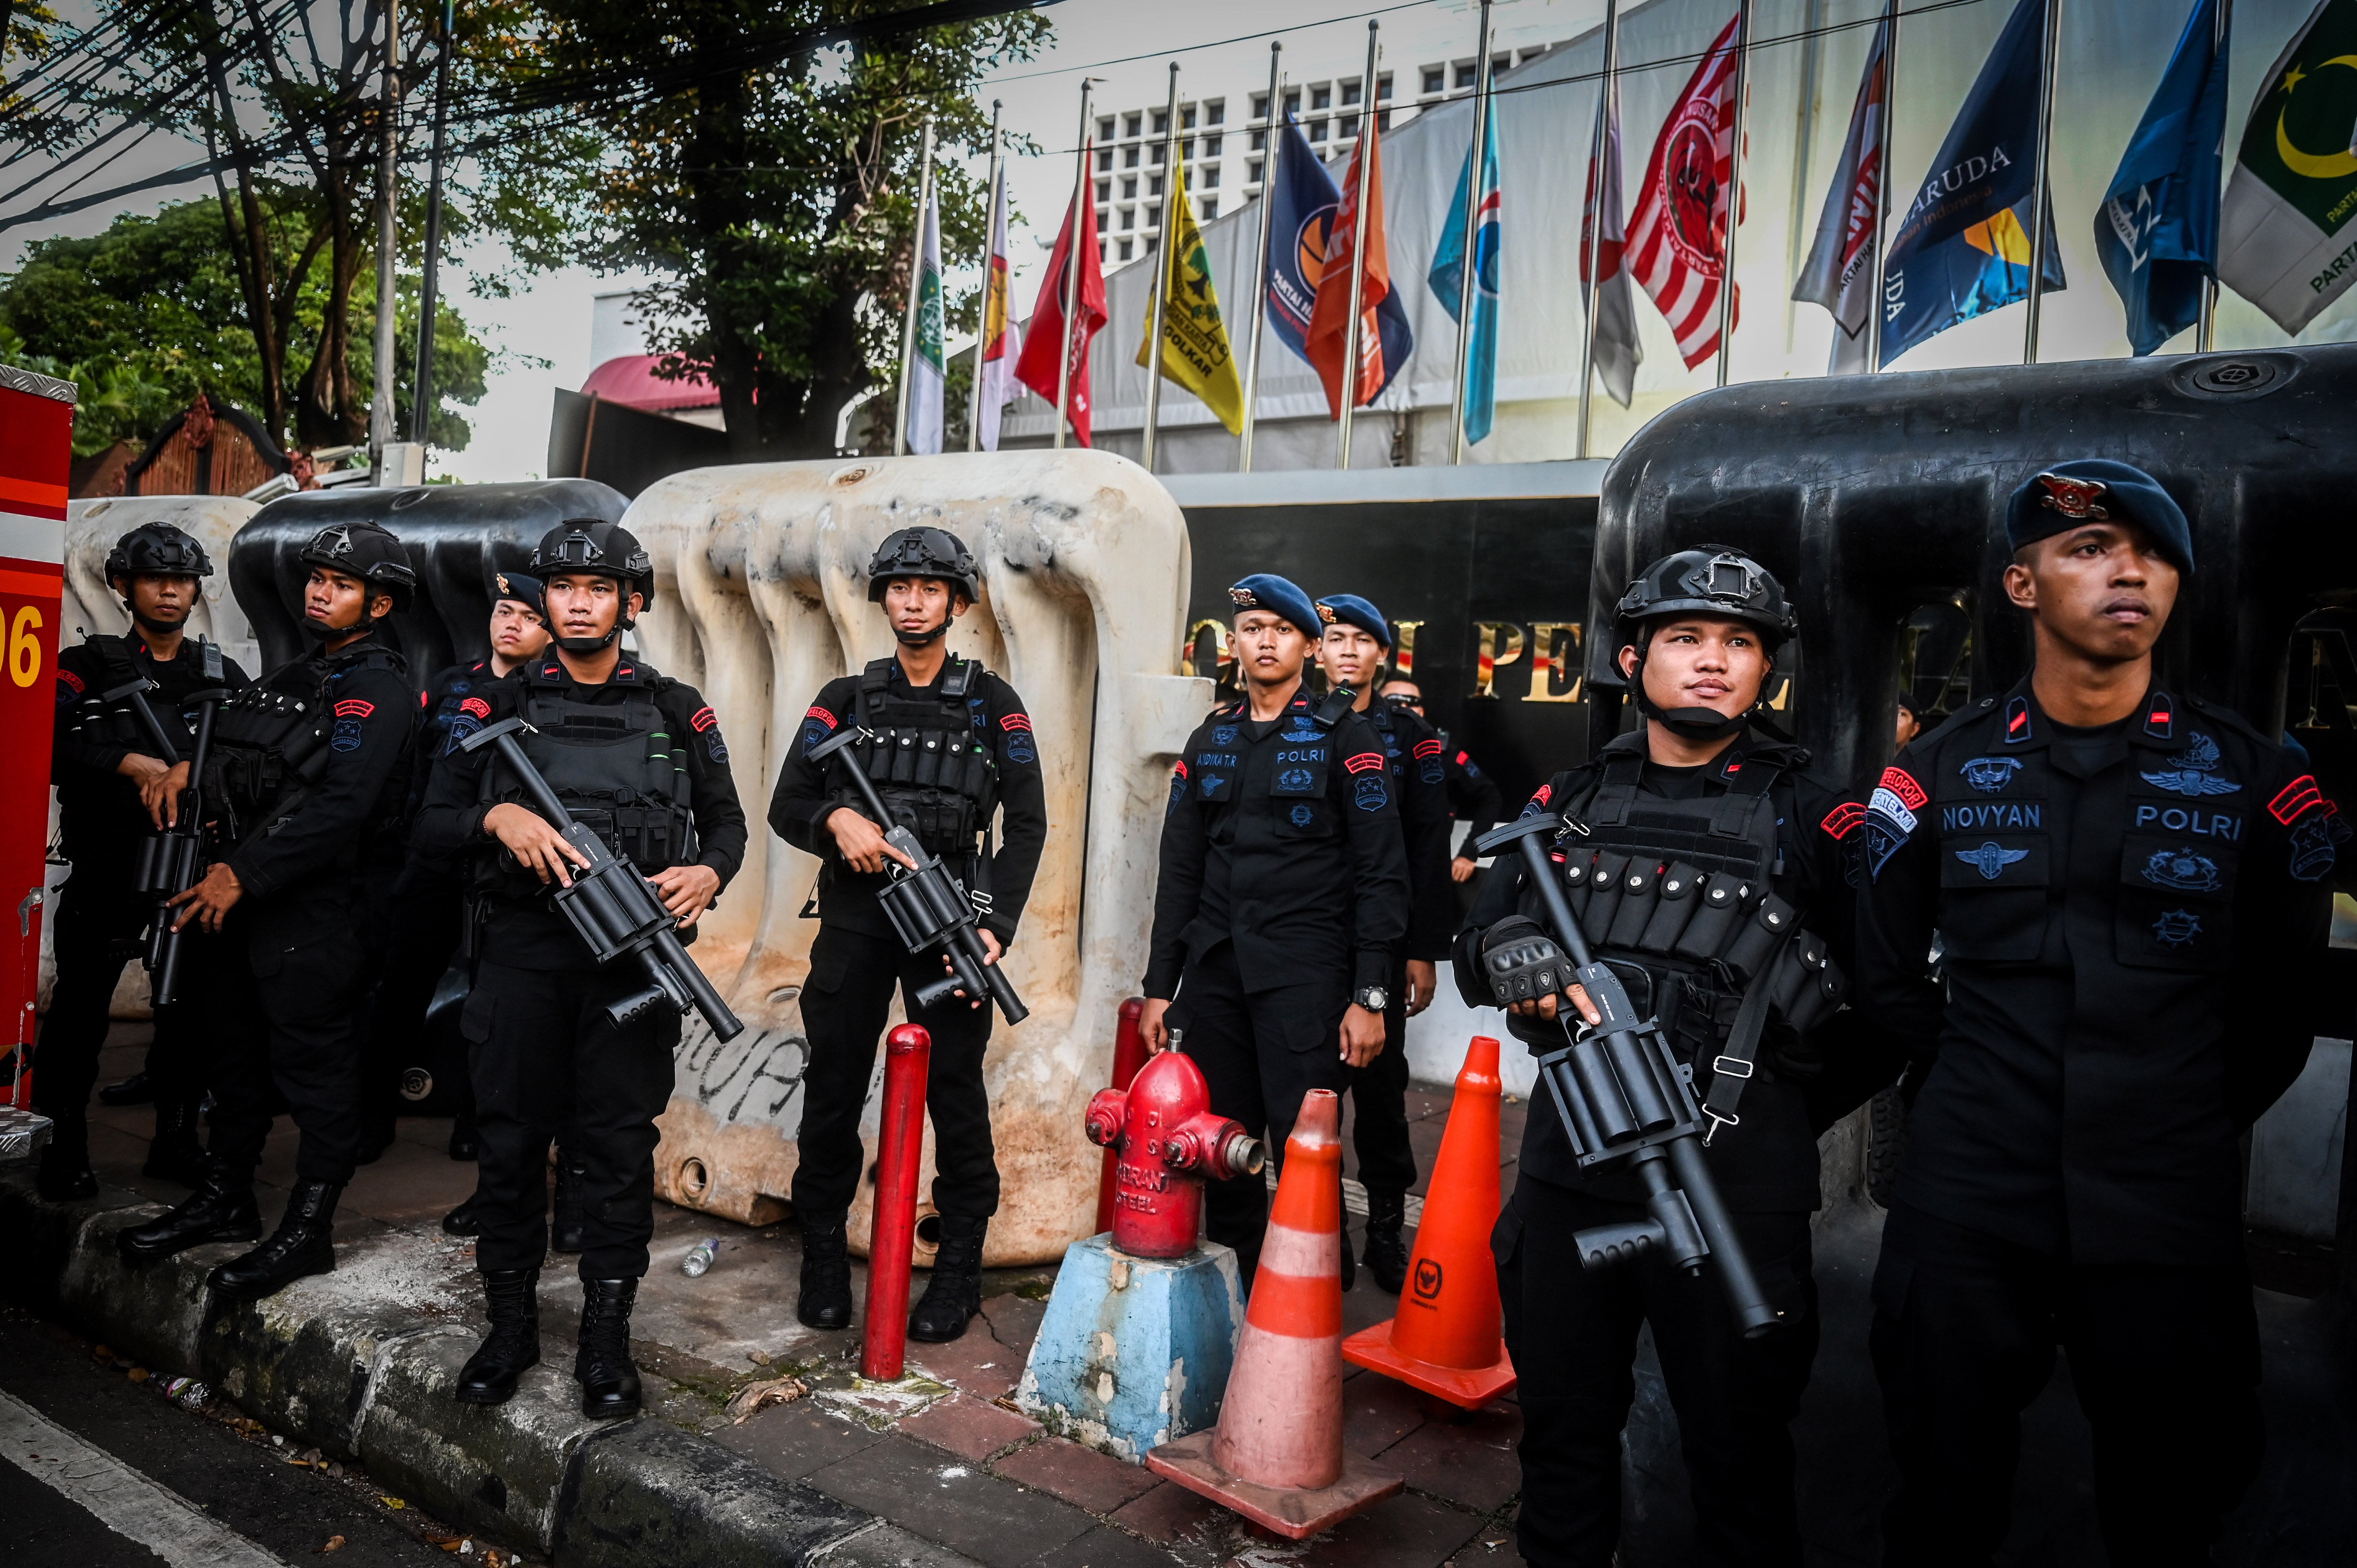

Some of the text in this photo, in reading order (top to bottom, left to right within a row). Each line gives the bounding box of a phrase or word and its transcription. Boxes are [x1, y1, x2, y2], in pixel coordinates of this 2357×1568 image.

[1838, 258, 1863, 298] ARTAI
[1163, 325, 1212, 378] GOLKAR
[0, 605, 43, 688] 6
[808, 708, 835, 727] PELOPOR
[1196, 754, 1223, 767] ANDIKA
[1277, 748, 1324, 764] POLRI
[1883, 770, 1921, 806] PELOPOR
[1943, 804, 2040, 831] NOVYAN
[2135, 805, 2242, 842] POLRI
[1117, 1191, 1156, 1213] STEEL
